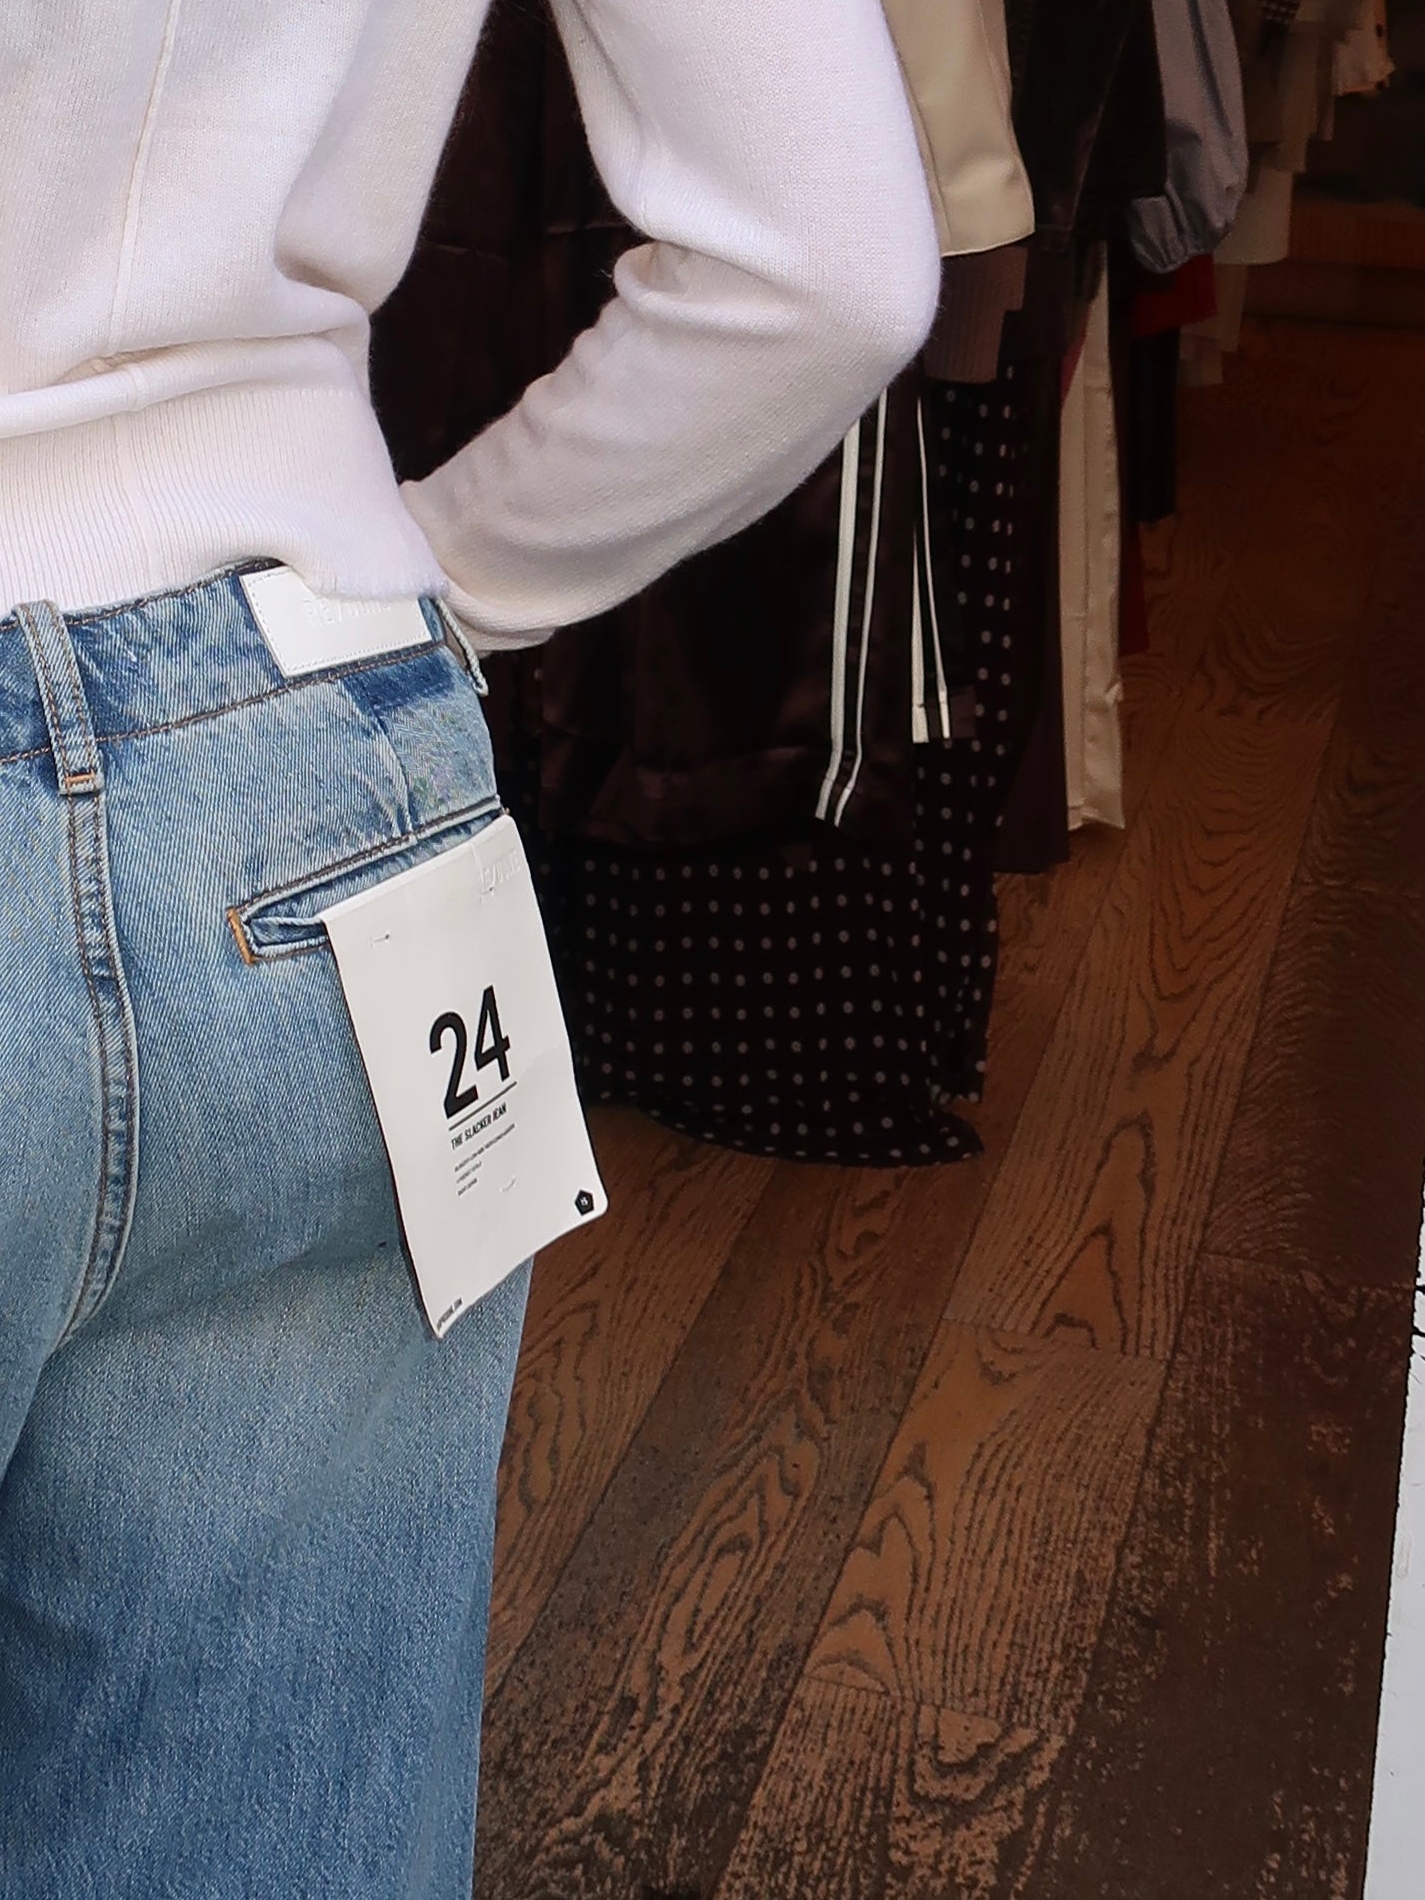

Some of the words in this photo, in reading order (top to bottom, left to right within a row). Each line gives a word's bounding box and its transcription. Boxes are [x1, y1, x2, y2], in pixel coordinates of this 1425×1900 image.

[429, 985, 511, 1120] 24
[451, 1133, 463, 1150] THE
[465, 1114, 492, 1141] SLACKER
